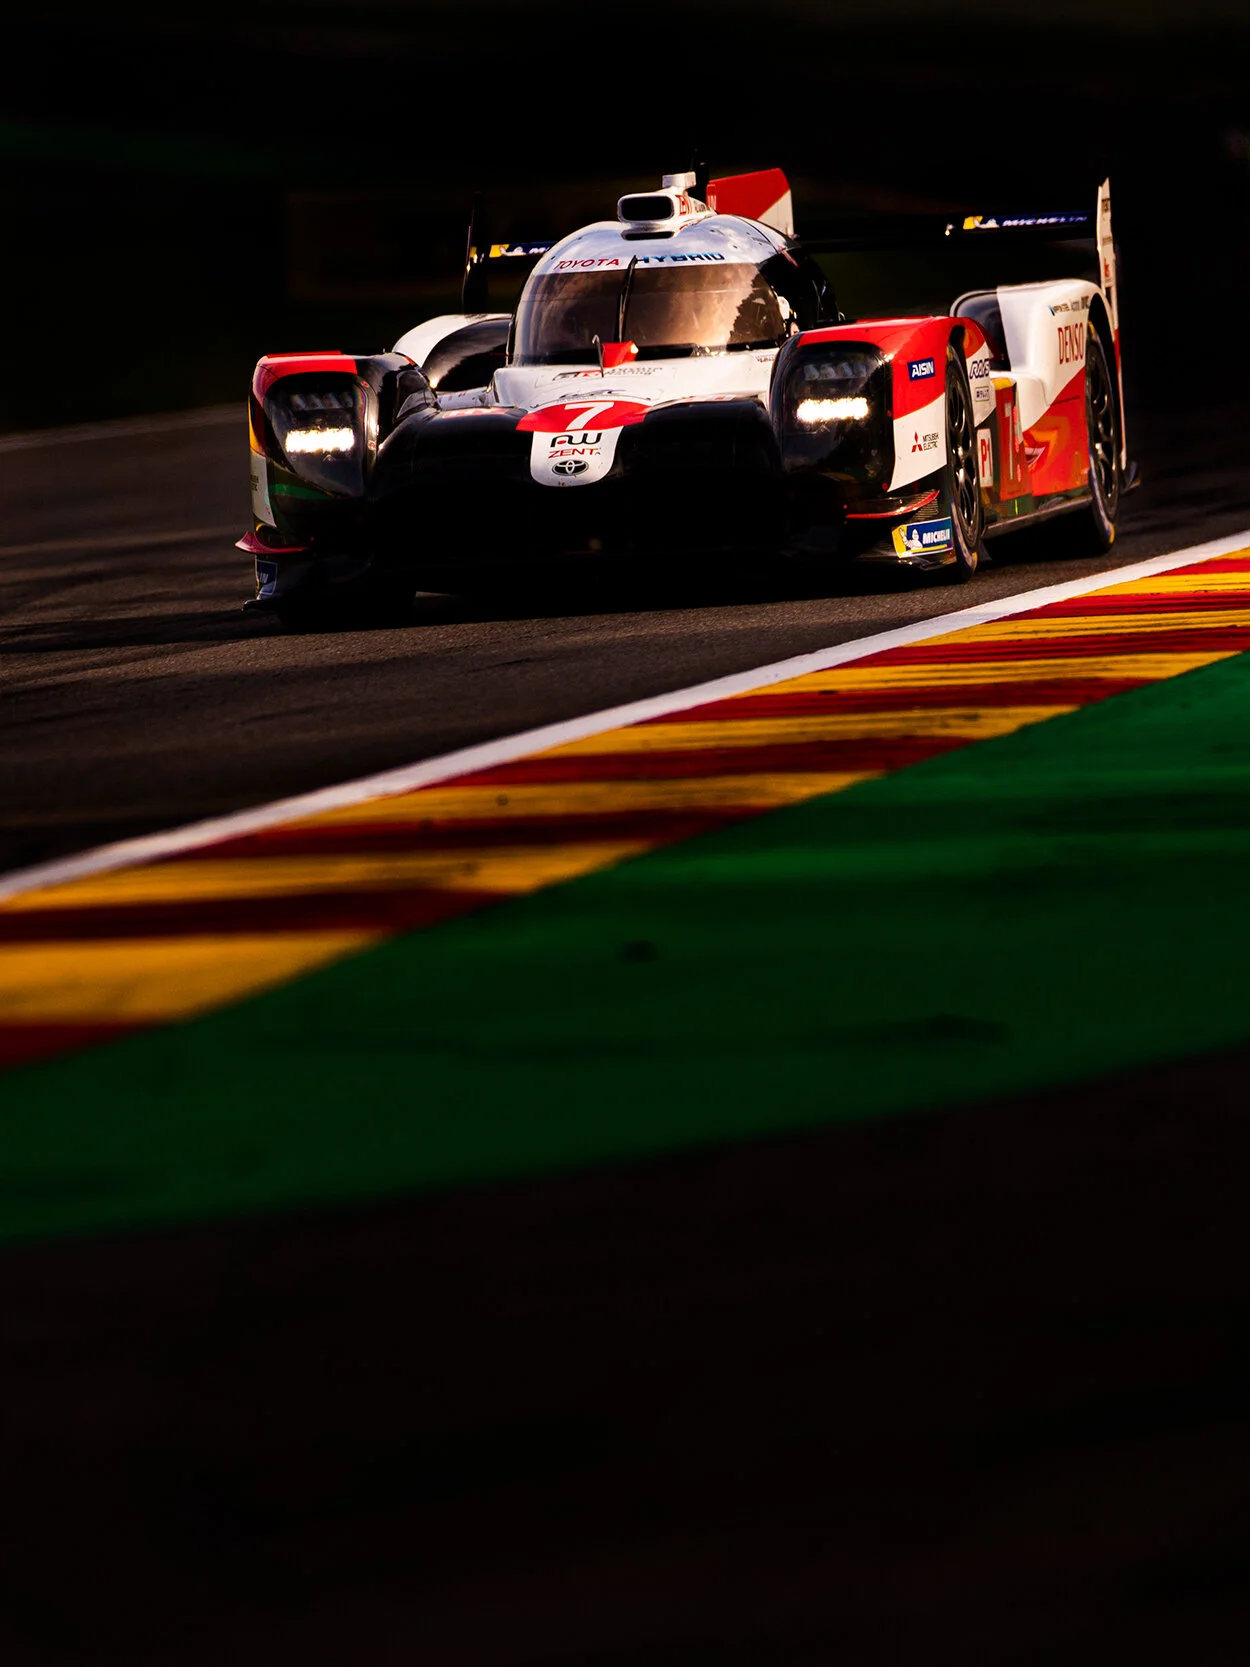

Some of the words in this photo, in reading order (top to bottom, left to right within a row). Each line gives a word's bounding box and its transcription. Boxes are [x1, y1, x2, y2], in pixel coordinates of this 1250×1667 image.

[553, 258, 620, 271] TOYOTA
[636, 253, 726, 265] HYBRID
[1058, 323, 1084, 365] DENSO
[912, 361, 934, 378] AISIN
[564, 402, 615, 430] 7
[548, 449, 598, 460] ZENT
[981, 437, 992, 478] P1
